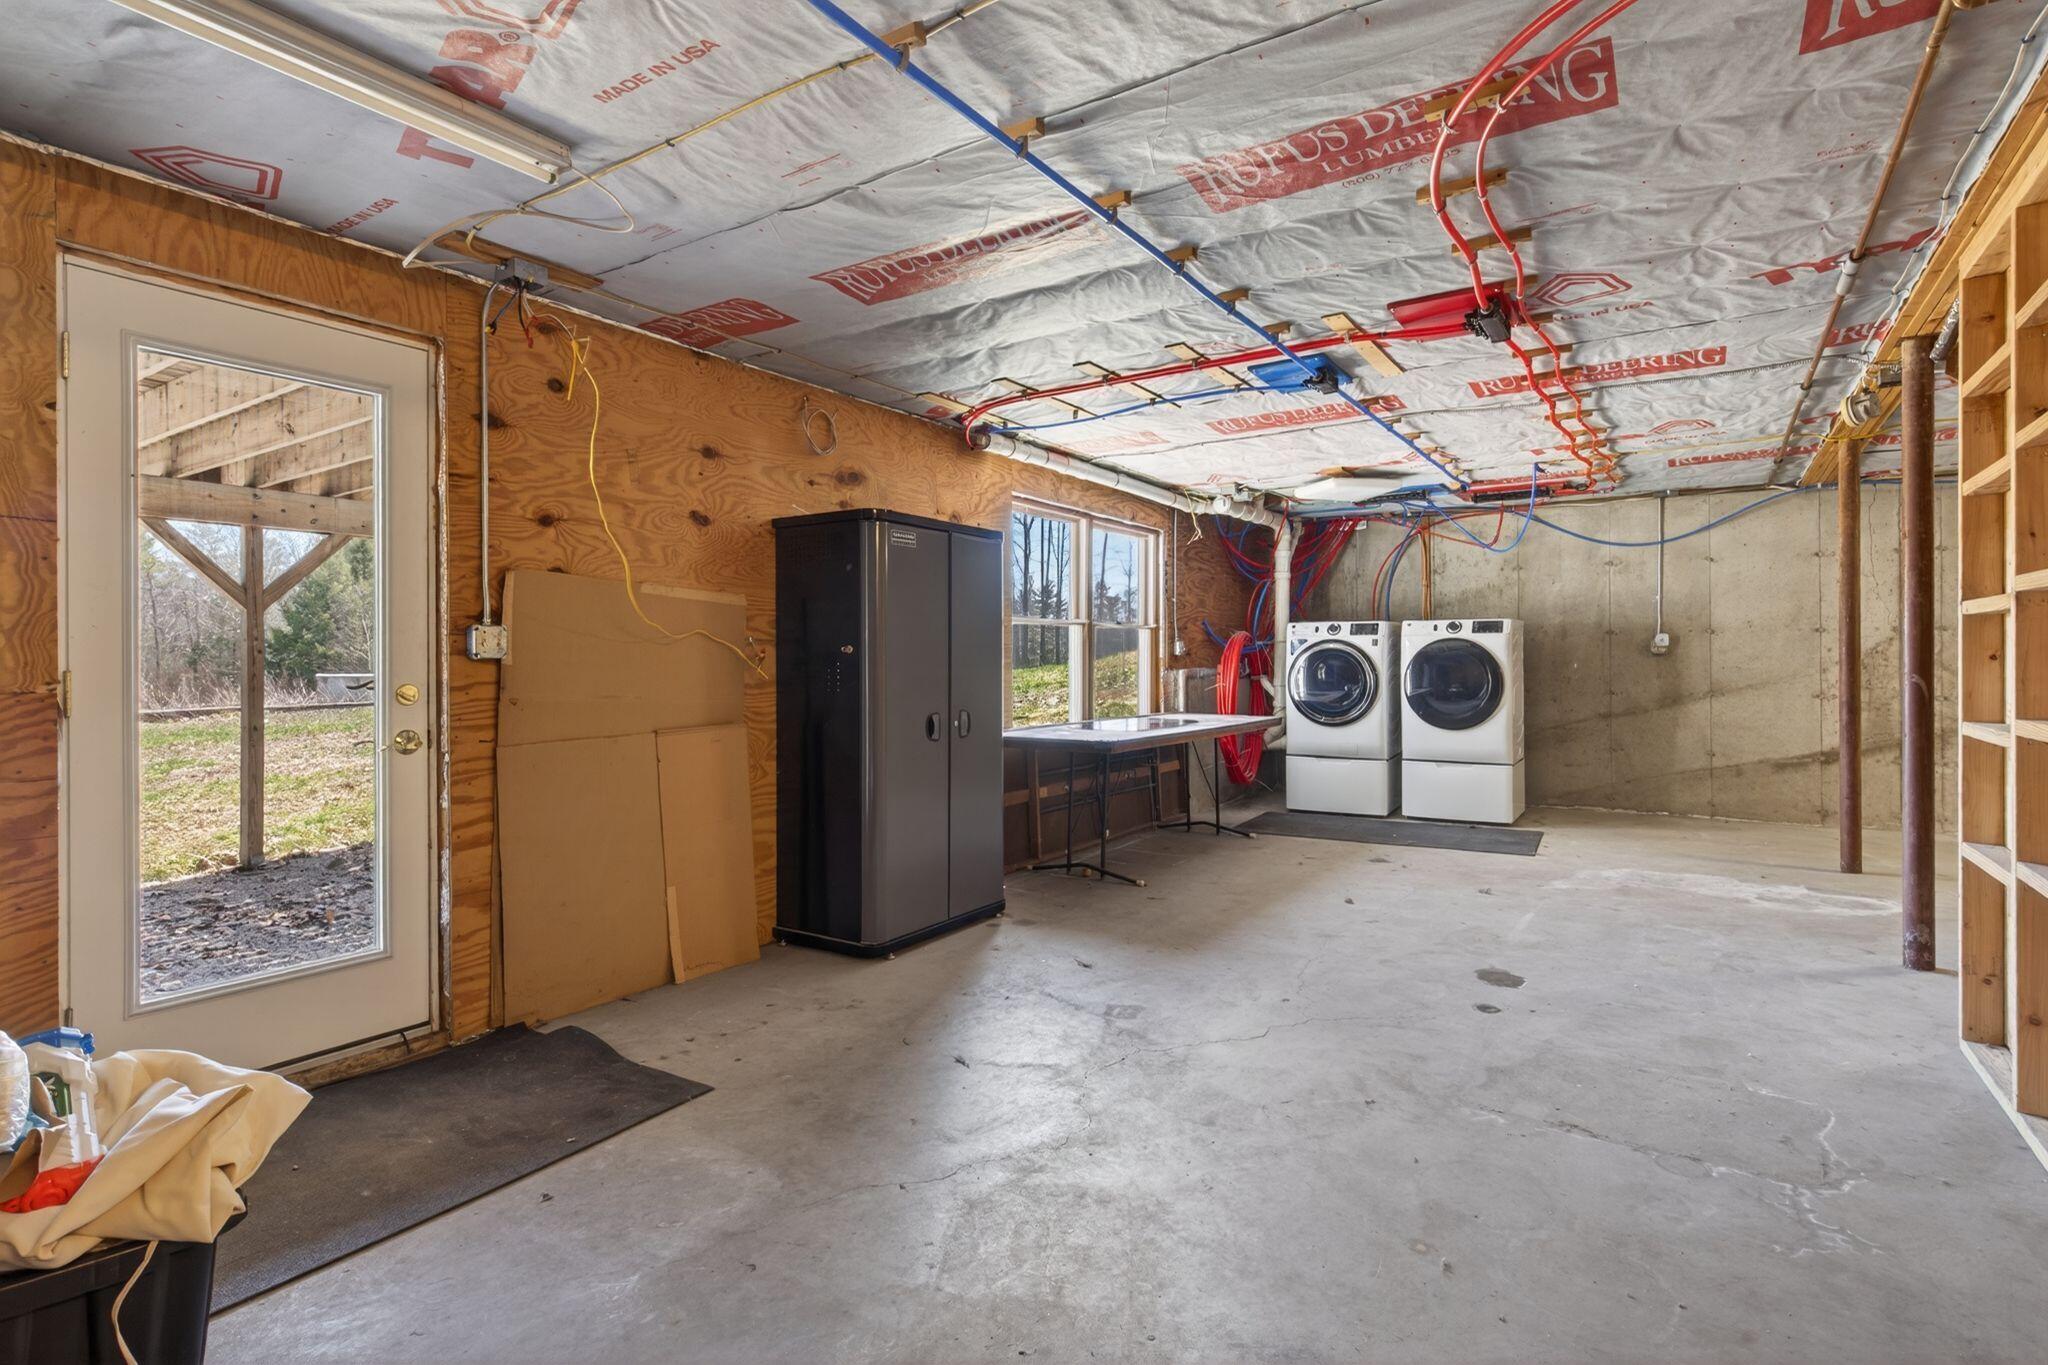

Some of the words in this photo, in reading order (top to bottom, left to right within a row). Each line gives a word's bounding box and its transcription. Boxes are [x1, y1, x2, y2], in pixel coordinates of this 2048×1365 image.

[592, 72, 652, 104] MADE
[647, 60, 677, 77] IN
[671, 38, 721, 65] USA
[1197, 122, 1349, 202] RUFUS
[368, 197, 400, 219] USA
[1582, 347, 1722, 376] DEERING
